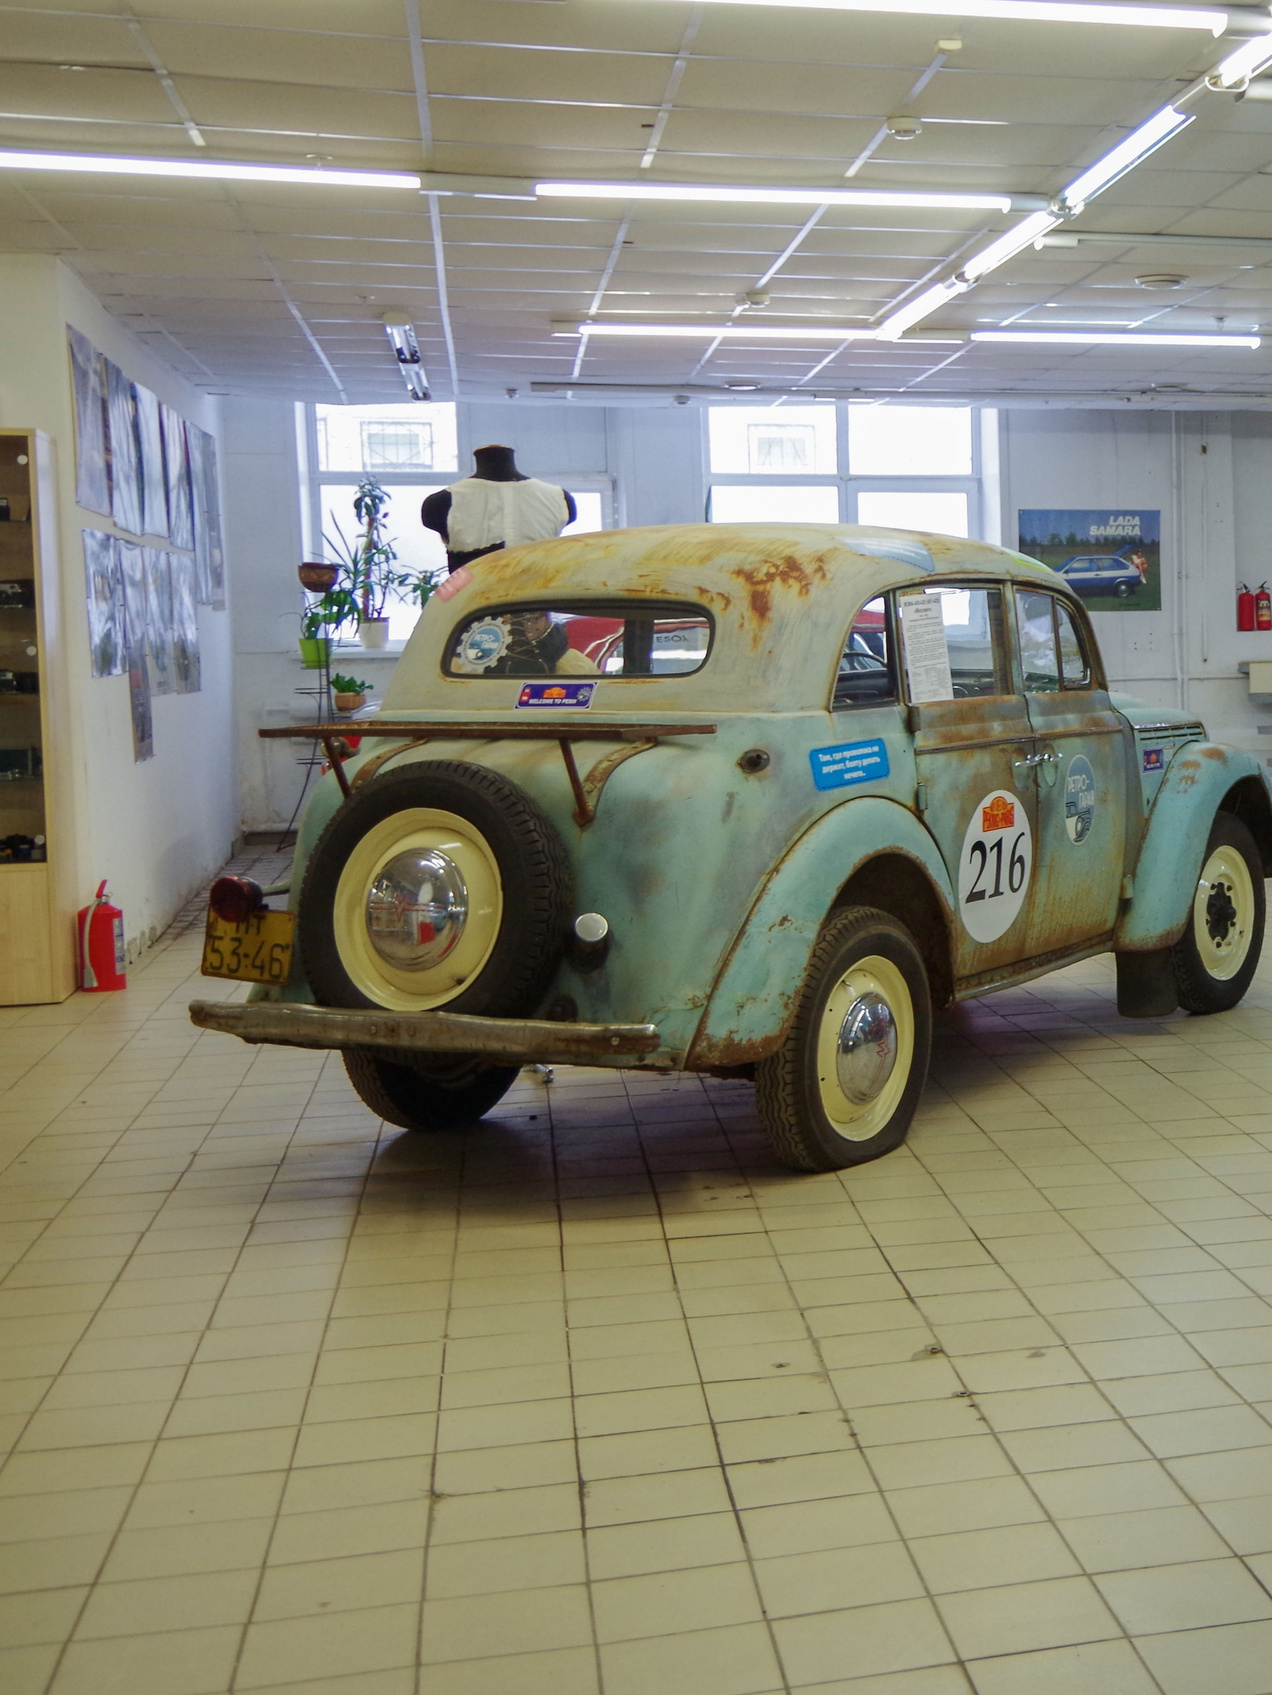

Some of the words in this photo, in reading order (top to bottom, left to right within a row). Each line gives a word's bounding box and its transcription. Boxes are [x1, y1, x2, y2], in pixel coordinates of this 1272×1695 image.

[1109, 516, 1140, 526] LADA
[1089, 525, 1141, 536] SAMARA
[1067, 774, 1090, 792] РЕТРО-
[965, 831, 1026, 905] 216
[208, 934, 284, 979] 53-46
